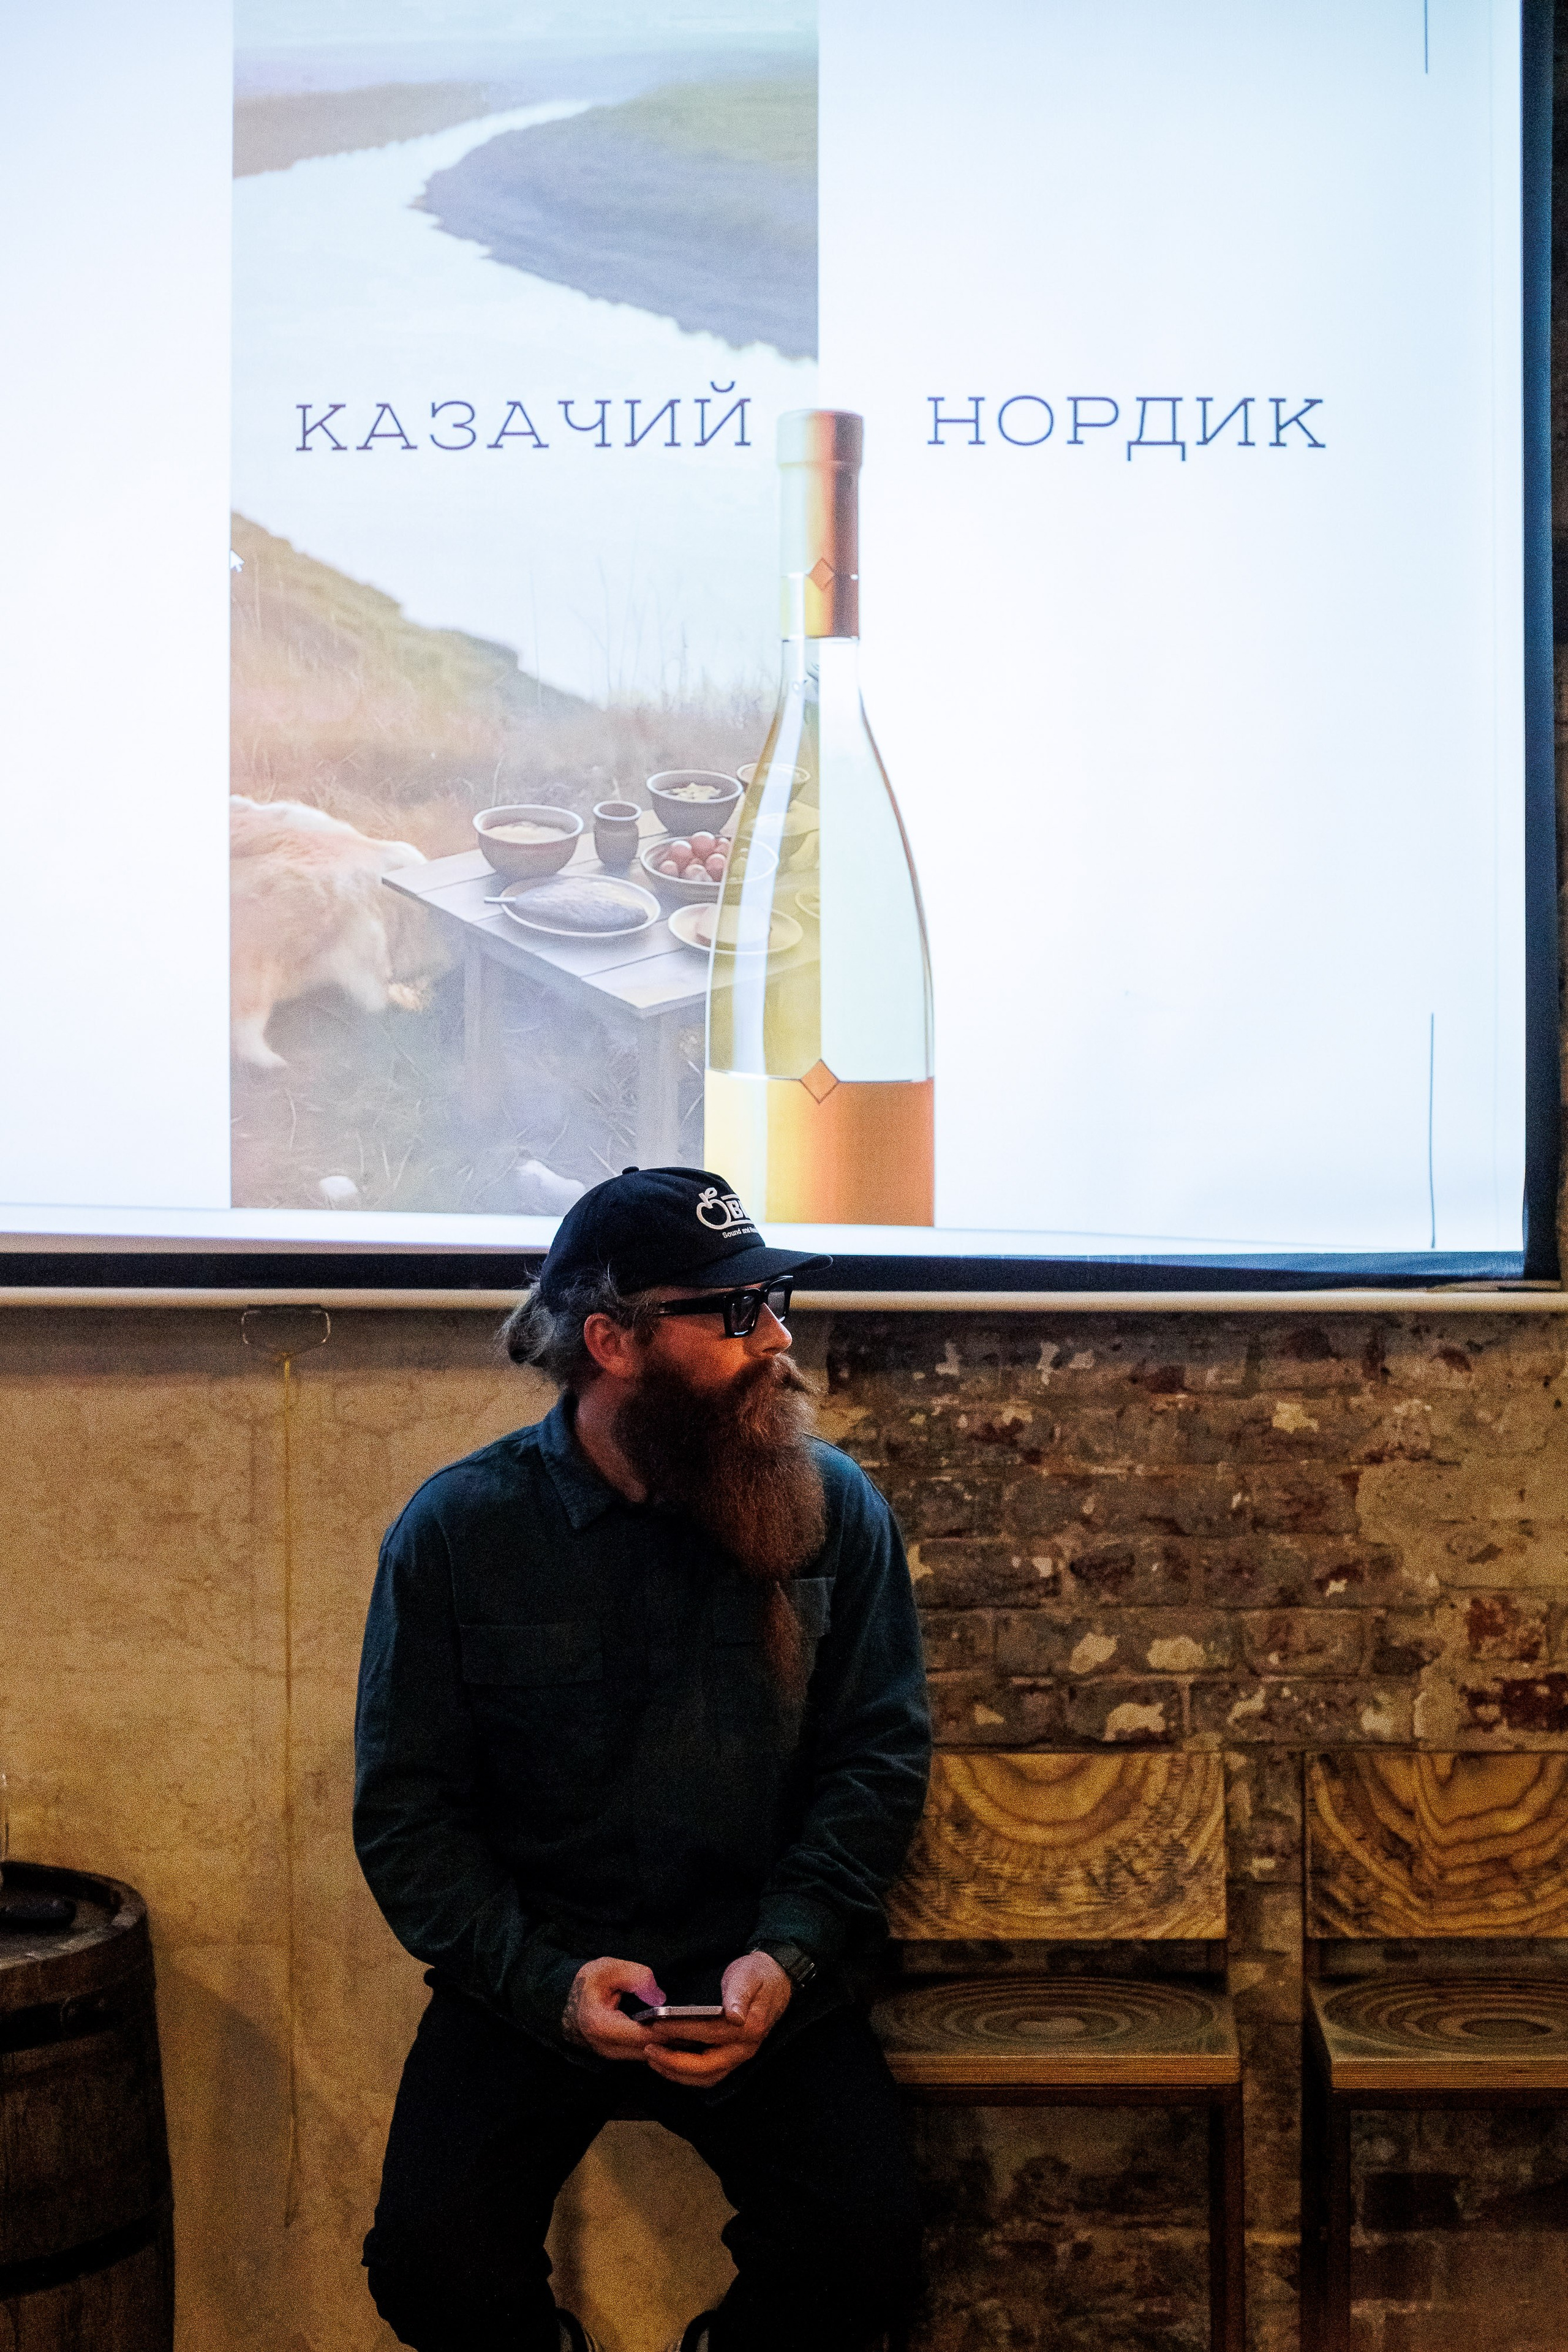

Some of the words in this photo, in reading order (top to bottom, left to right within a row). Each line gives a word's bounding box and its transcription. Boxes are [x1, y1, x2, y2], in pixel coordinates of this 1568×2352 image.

[295, 380, 752, 452] КАЗАЧИЙ
[927, 394, 1327, 462] НОРДИК
[722, 1227, 742, 1238] Sound
